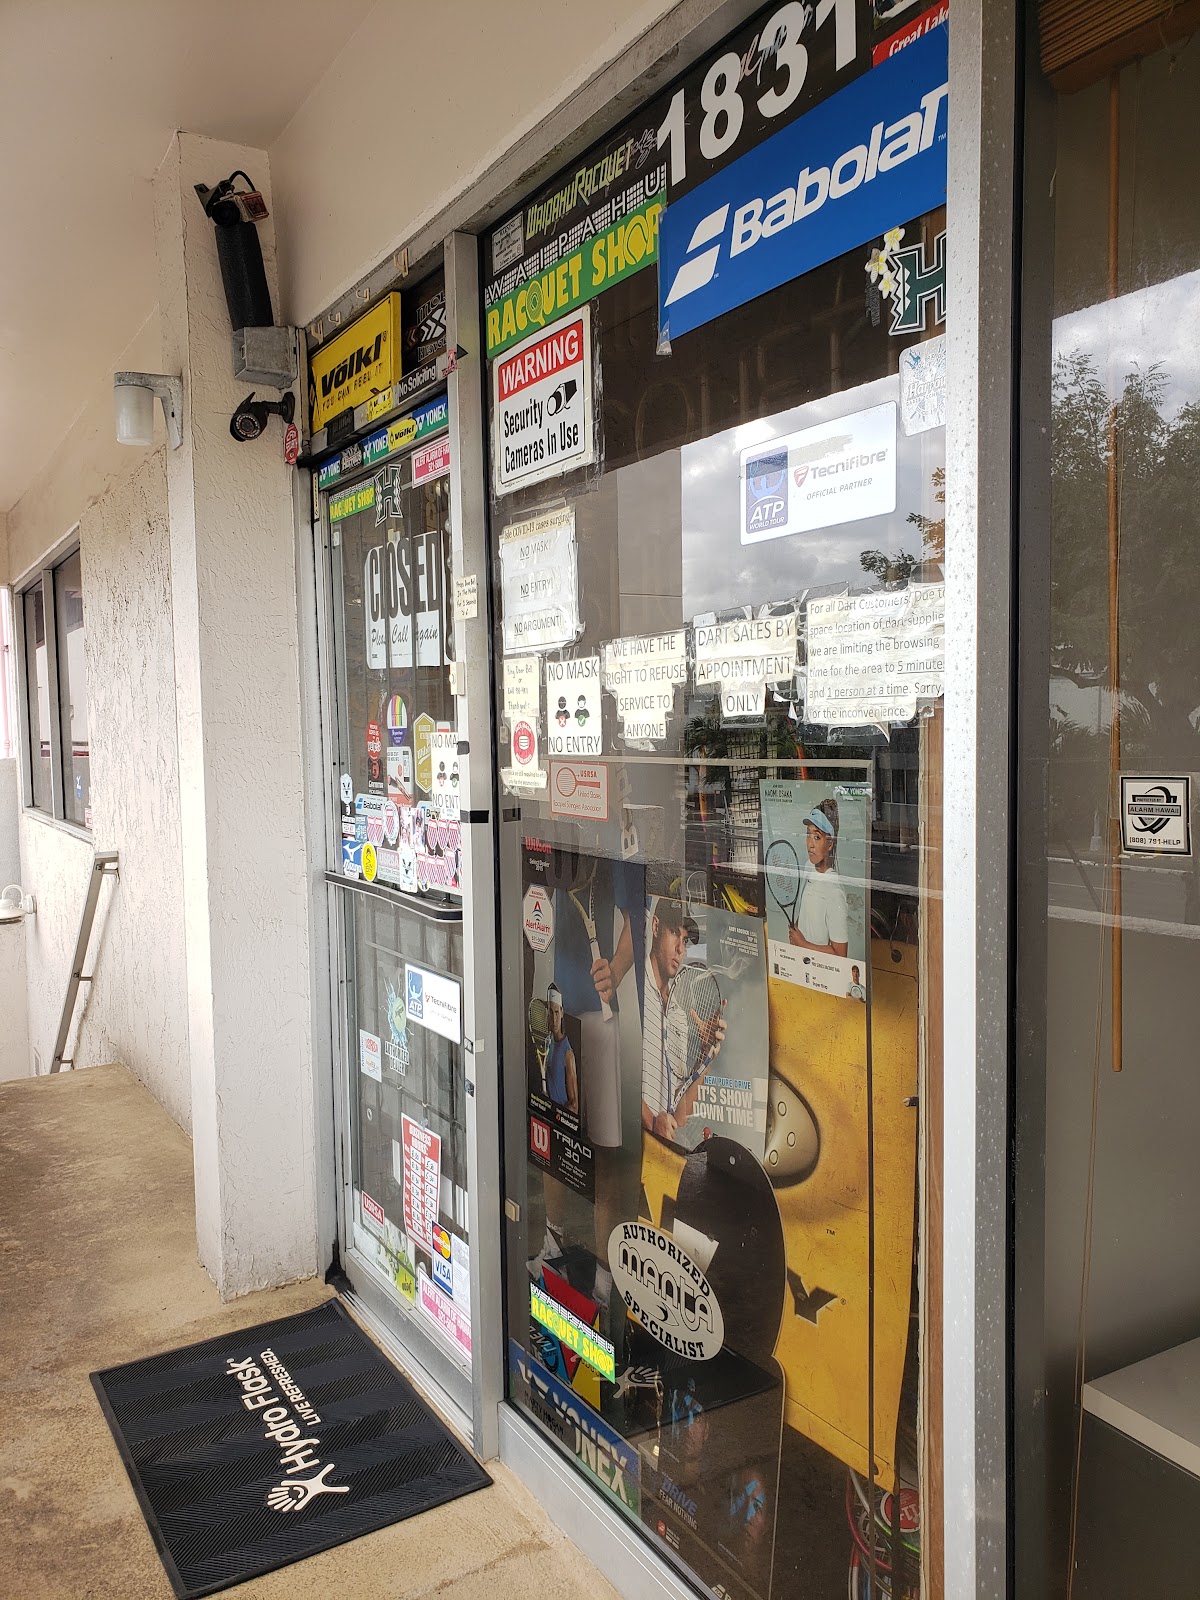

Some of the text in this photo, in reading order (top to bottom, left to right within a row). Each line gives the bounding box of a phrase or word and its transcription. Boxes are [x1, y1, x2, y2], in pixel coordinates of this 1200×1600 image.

[888, 22, 923, 57] Great
[657, 0, 857, 187] 1831
[487, 252, 583, 350] RACQUET
[592, 202, 663, 287] SHOP
[502, 329, 579, 395] WARNING
[400, 365, 437, 396] No Soliciting
[426, 402, 446, 427] YONEX
[504, 398, 544, 439] Security
[505, 421, 579, 473] Cameras In Use
[811, 449, 886, 480] Tecnifibre
[806, 477, 873, 501] OFFICIAL PARTNER
[750, 500, 784, 524] ATP
[750, 516, 785, 530] WORLD TOUR
[520, 545, 530, 559] NO
[520, 583, 530, 597] NO
[810, 603, 824, 615] For
[825, 600, 836, 613] all
[838, 599, 856, 612] Dart
[392, 624, 439, 648] Call gain
[514, 621, 523, 634] NO
[698, 617, 793, 647] DART SALES BY
[809, 625, 833, 638] space
[835, 621, 871, 635] location
[872, 618, 883, 630] of
[613, 635, 676, 658] WE HAVE THE
[809, 636, 940, 656] we are limiting the browsing
[549, 659, 598, 681] NO MASK
[606, 663, 686, 686] RIGHT TO REFUSE
[697, 655, 795, 681] APPOINTMENT
[809, 658, 945, 678] time for the area to 5 minute
[809, 687, 825, 699] and
[834, 687, 864, 699] person
[866, 686, 877, 696] at
[878, 686, 884, 695] a
[914, 681, 942, 696] Sorry
[619, 694, 671, 711] SERVICE TO
[725, 694, 759, 713] ONLY
[823, 707, 837, 718] the
[432, 734, 444, 748] NO
[626, 723, 665, 738] ANYONE
[549, 736, 601, 754] NO ENTRY
[432, 793, 444, 807] NO
[1129, 836, 1147, 845] (808)
[409, 1002, 422, 1014] ATP
[704, 1075, 752, 1090] NEW PURE DRIVE
[697, 1084, 753, 1109] IT'S SHOW
[692, 1100, 754, 1128] DOWN TIME
[553, 1129, 592, 1159] TRIAD
[434, 1257, 452, 1283] VISA
[623, 1224, 710, 1297] AUTHORIZED
[531, 1295, 579, 1349] RACQUET
[582, 1339, 614, 1376] SHOP
[623, 1289, 705, 1359] SPECIALIST
[226, 1356, 321, 1475] Hydro Flask
[294, 1400, 322, 1426] LIVE
[552, 1391, 629, 1504] YONEX
[659, 1488, 698, 1531] FEAR NOTHING
